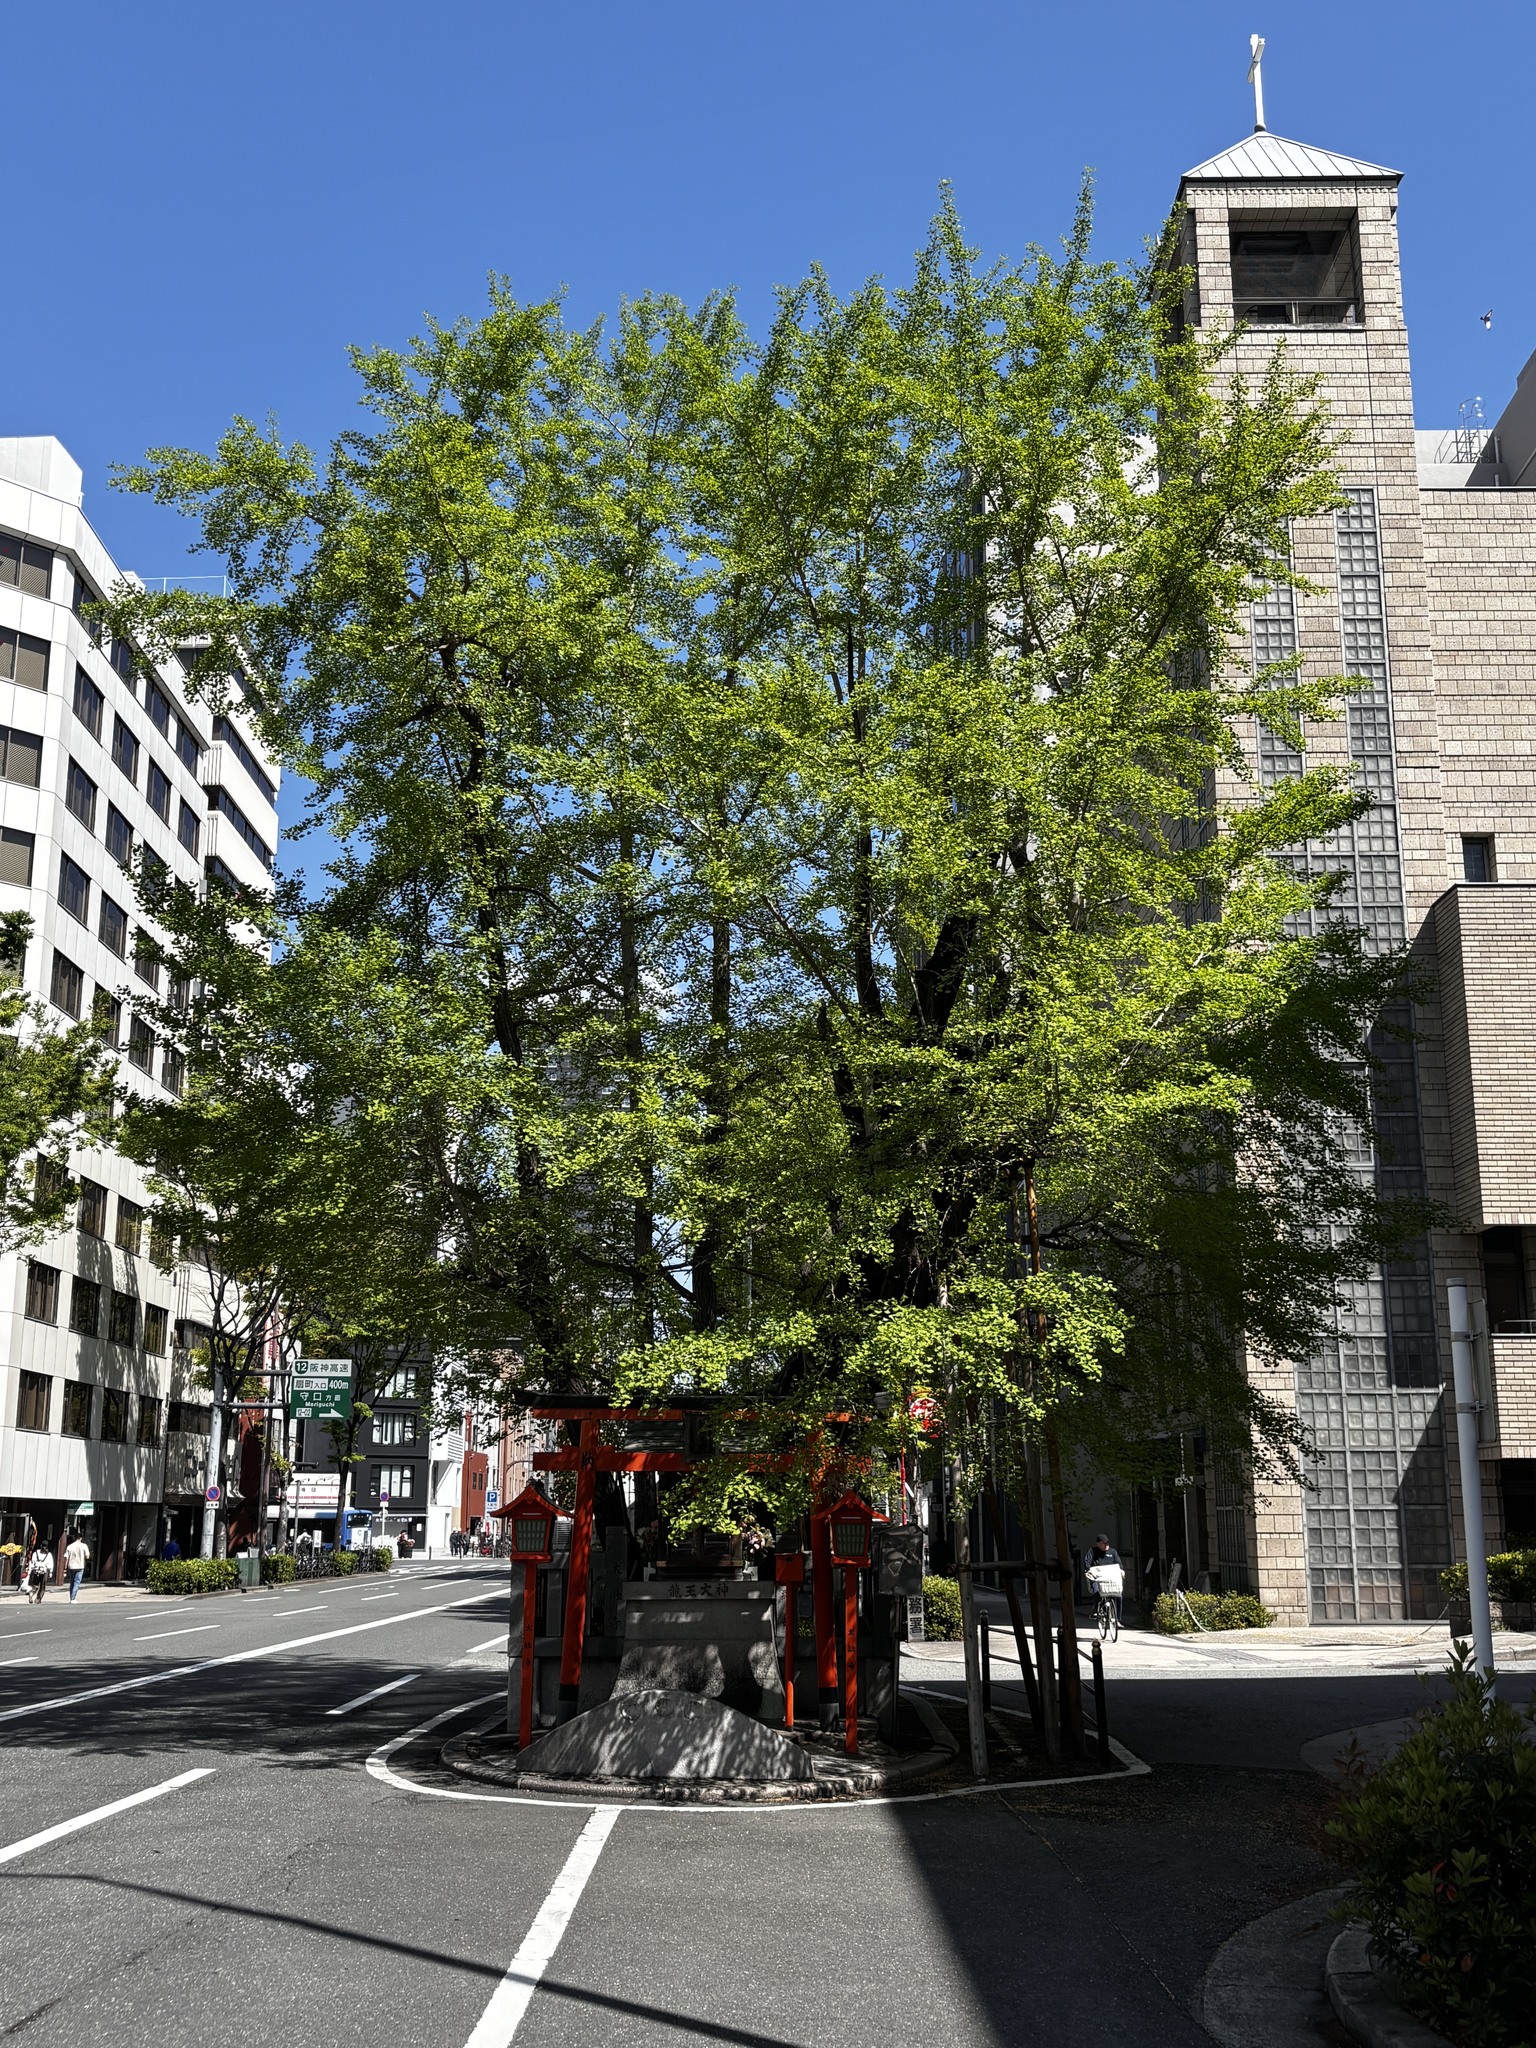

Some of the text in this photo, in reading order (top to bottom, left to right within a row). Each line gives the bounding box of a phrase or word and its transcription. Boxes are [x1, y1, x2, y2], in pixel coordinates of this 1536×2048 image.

[296, 1362, 349, 1372] 12 阪神高速
[329, 1380, 349, 1389] 400m
[489, 1492, 496, 1502] P
[668, 1582, 729, 1598] 龍王大神
